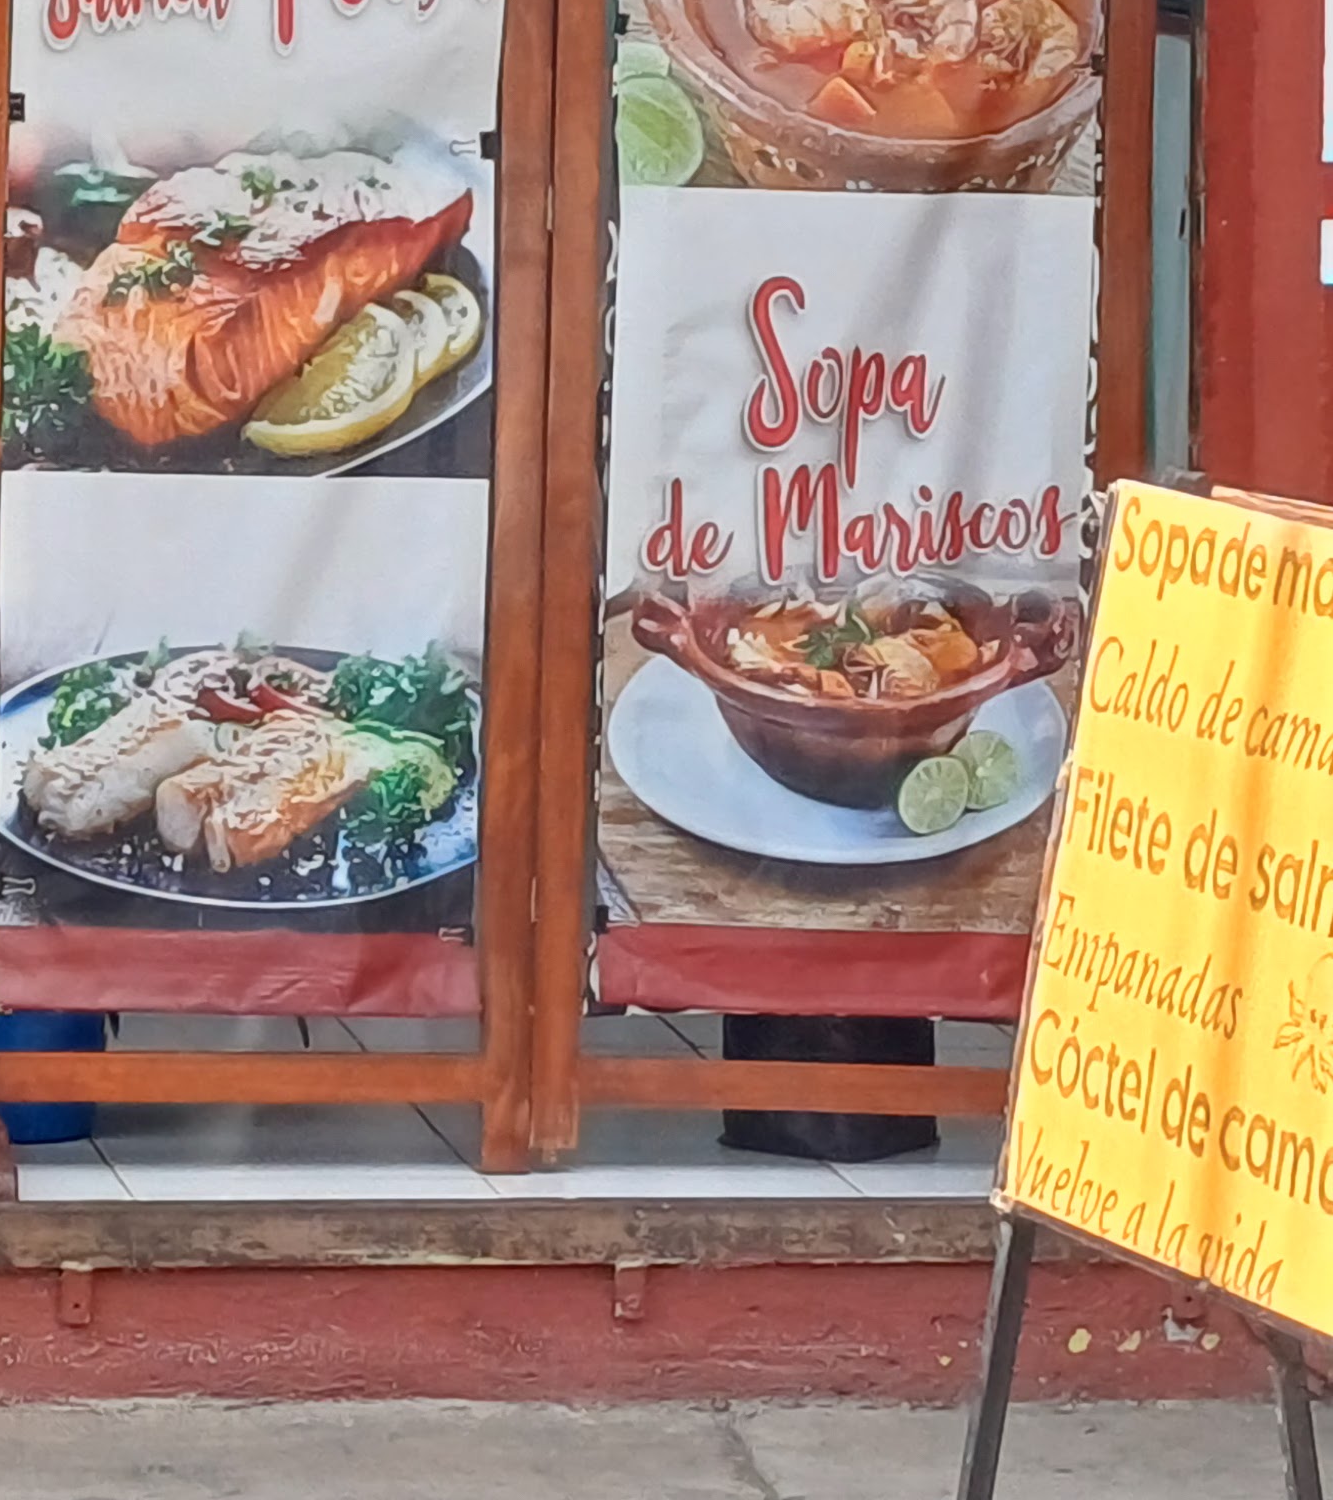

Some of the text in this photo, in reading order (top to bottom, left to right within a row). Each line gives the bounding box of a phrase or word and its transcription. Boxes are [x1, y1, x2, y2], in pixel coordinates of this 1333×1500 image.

[748, 275, 946, 487] Sopa
[645, 463, 1078, 582] de Mariscos
[1113, 496, 1216, 602] Sopa
[1218, 521, 1268, 601] de
[1089, 636, 1188, 733] Caldo
[1195, 659, 1244, 746] de
[1066, 765, 1173, 876] Filete
[1183, 807, 1238, 900] de
[1043, 890, 1244, 1041] Empanadas
[1030, 1008, 1157, 1134] Cóctel
[1160, 1063, 1211, 1159] de
[1015, 1120, 1284, 1306] Vuelve a la vida
